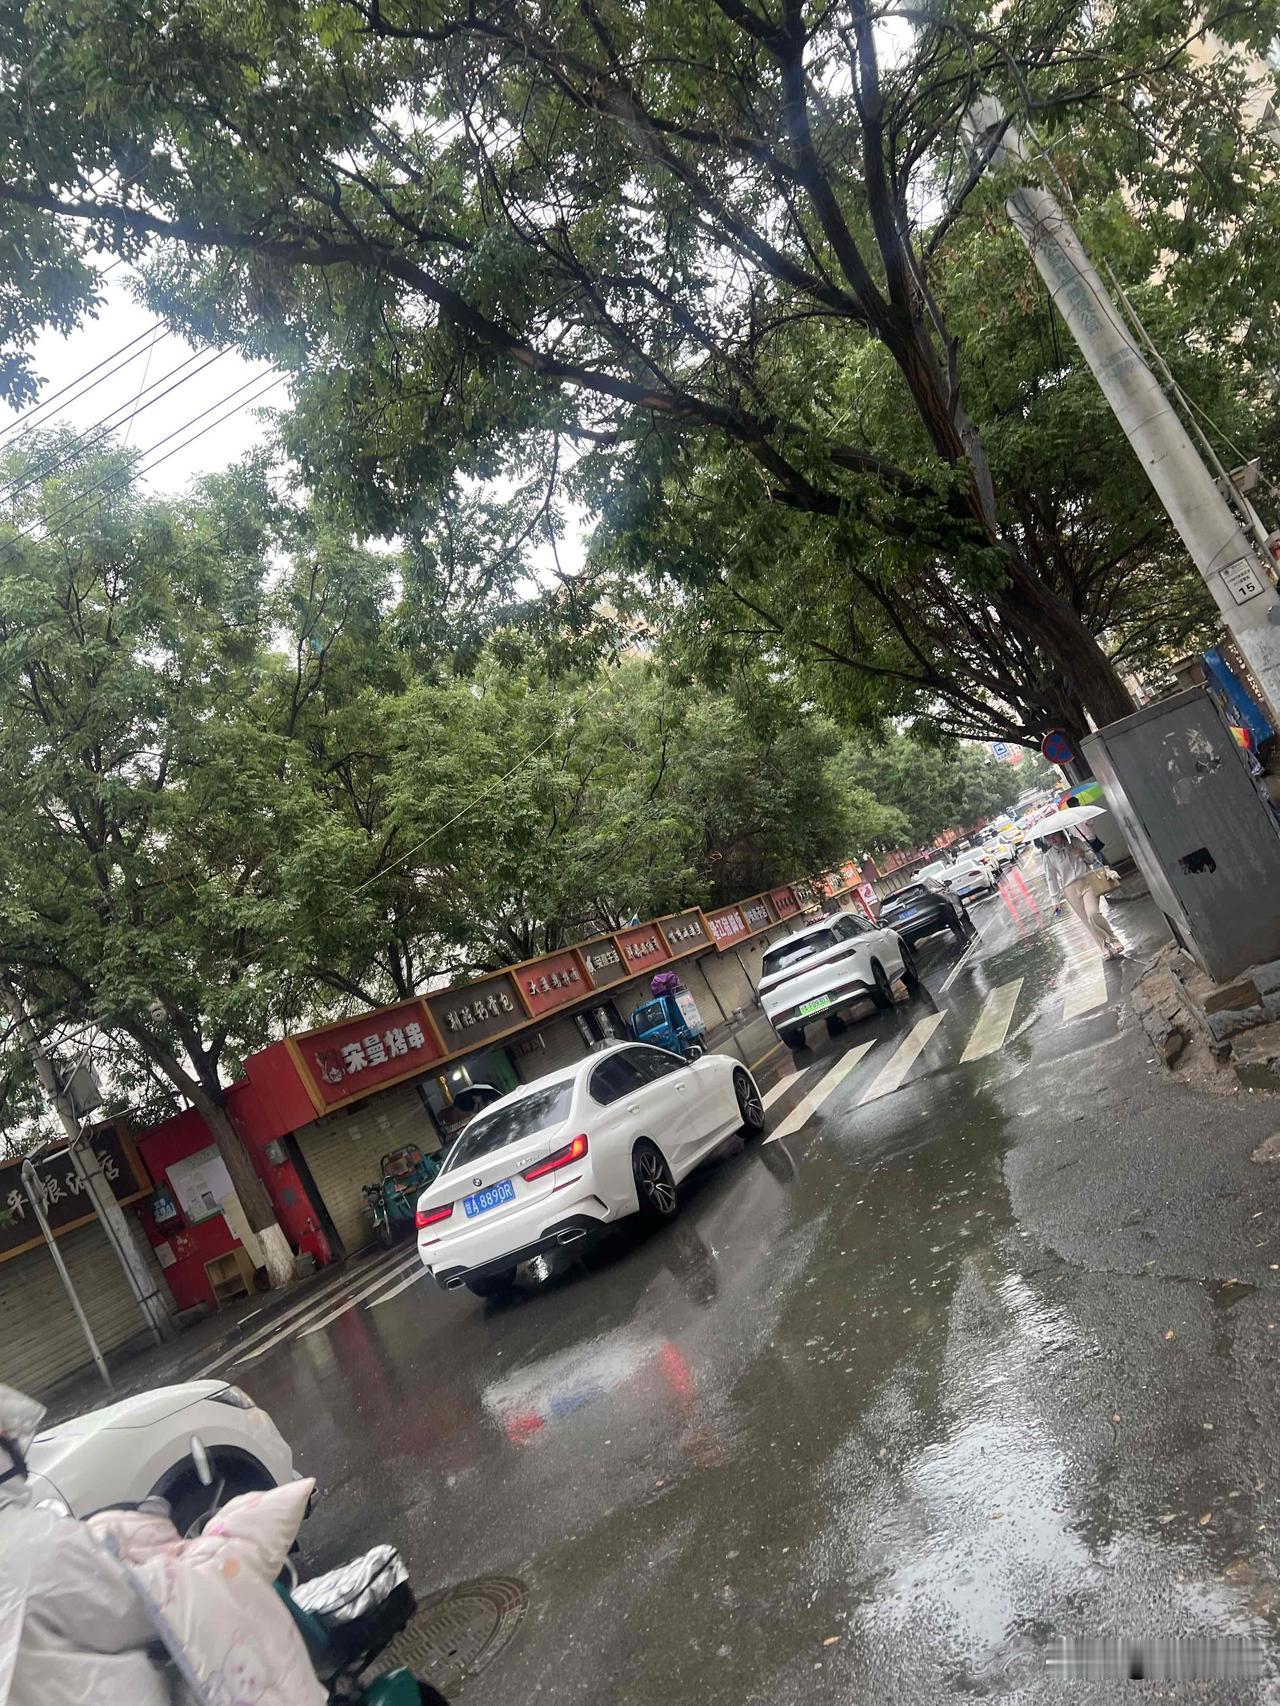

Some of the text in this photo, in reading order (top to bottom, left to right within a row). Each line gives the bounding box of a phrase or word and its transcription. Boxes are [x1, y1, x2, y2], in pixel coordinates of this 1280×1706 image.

[1238, 582, 1256, 596] 15
[340, 1021, 427, 1076] 宋曼烤串
